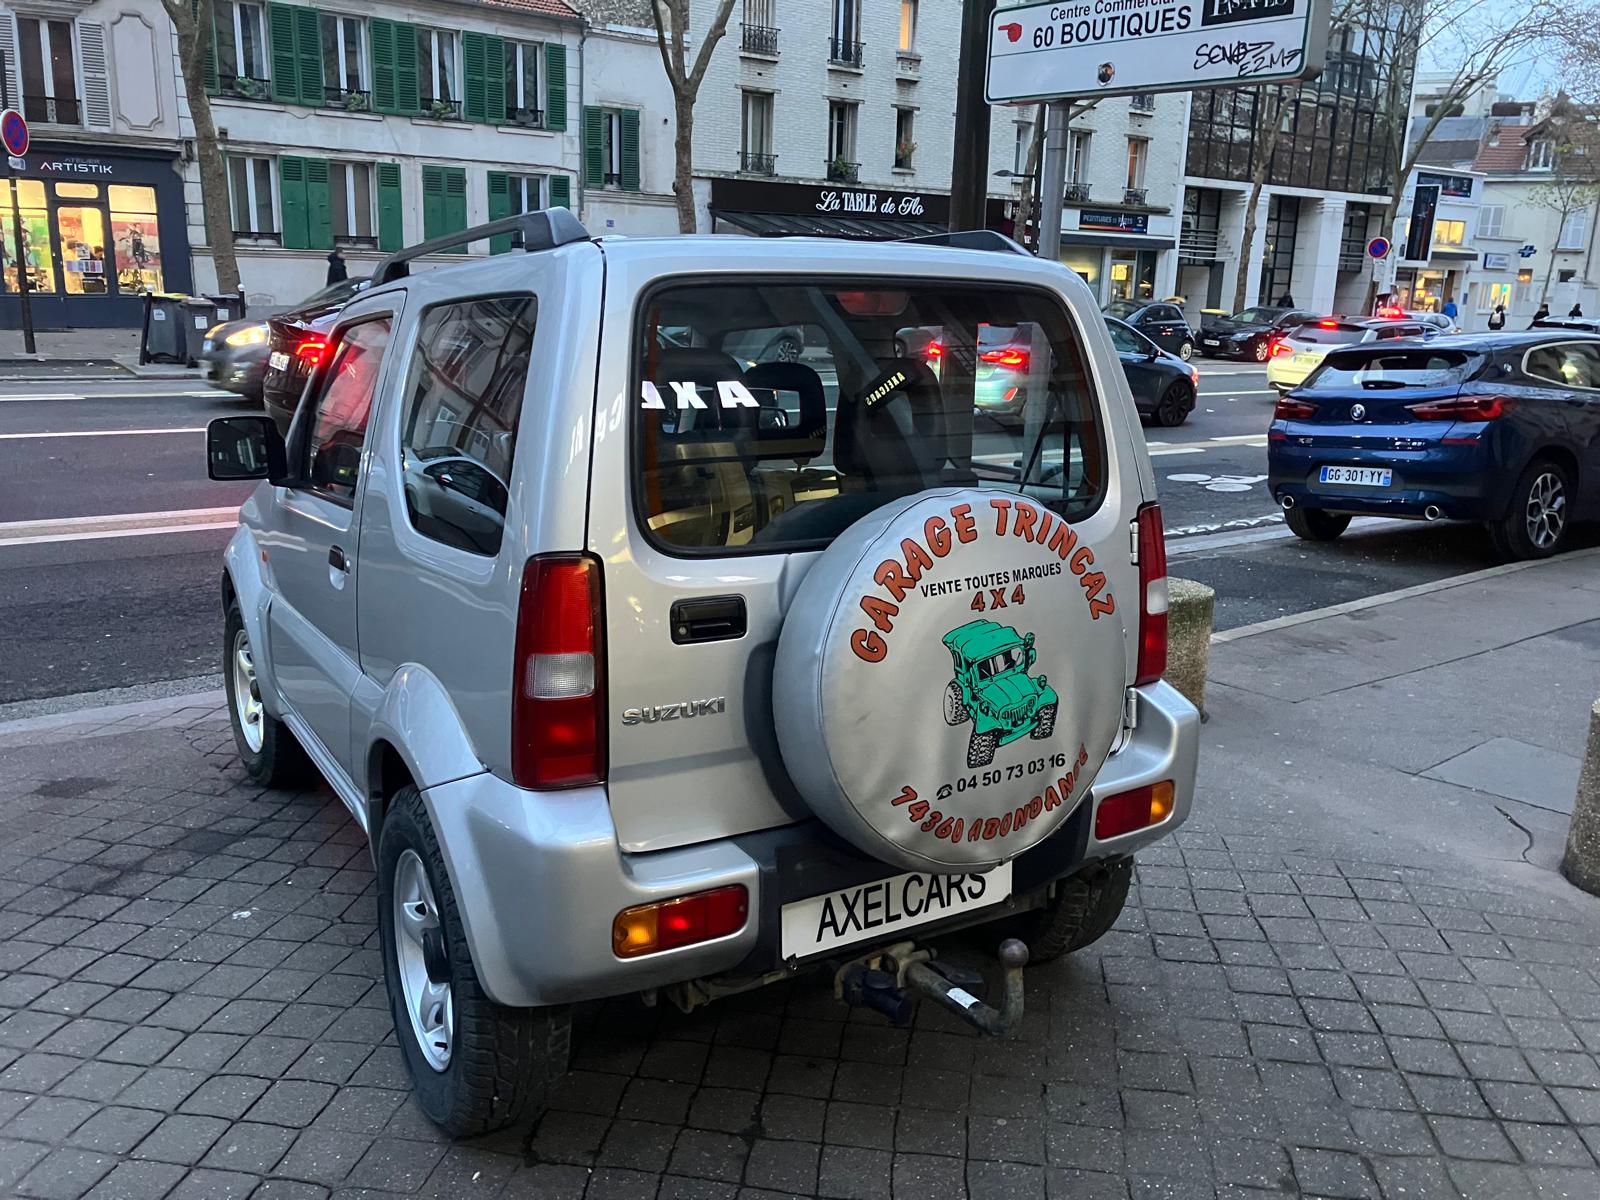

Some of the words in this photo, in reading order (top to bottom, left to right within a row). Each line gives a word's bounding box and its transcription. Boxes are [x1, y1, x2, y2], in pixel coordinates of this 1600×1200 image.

[1033, 26, 1054, 48] 60
[1061, 5, 1192, 45] BOUTIQUES
[1051, 4, 1091, 21] Centre
[1094, 0, 1175, 14] Commerc
[40, 162, 113, 174] ARTISTIK
[816, 191, 841, 212] La
[842, 192, 877, 213] TABLE
[881, 197, 896, 214] de
[898, 196, 924, 216] Flo
[850, 502, 978, 664] GARAGE
[989, 499, 1116, 621] TRINCAZ
[920, 579, 962, 598] VENTE
[965, 571, 1010, 590] TOUTES
[1012, 562, 1062, 582] MARQUES
[622, 697, 726, 726] SUZUKI
[956, 771, 978, 793] 04
[982, 765, 1003, 786] 50
[1005, 761, 1024, 780] 73
[1027, 758, 1045, 776] 03
[1048, 752, 1066, 769] 16
[890, 786, 964, 844] 74360
[816, 874, 987, 943] AXELCARS
